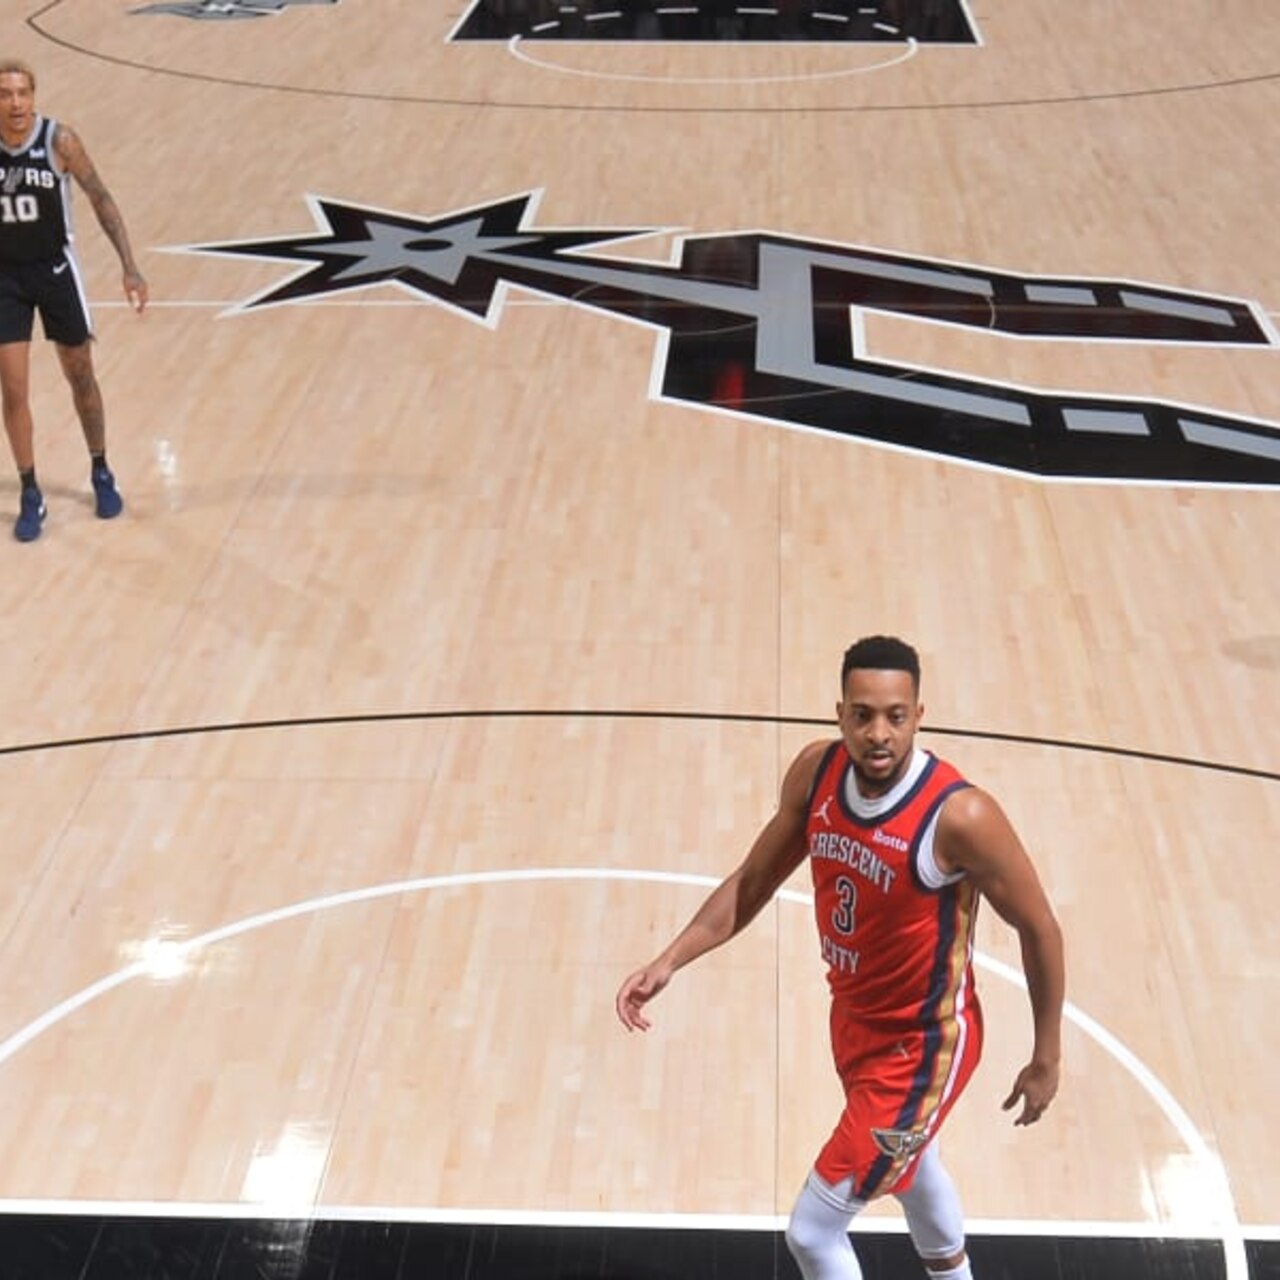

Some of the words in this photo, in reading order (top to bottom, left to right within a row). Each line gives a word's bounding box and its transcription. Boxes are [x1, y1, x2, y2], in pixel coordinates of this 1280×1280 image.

[0, 195, 39, 223] 10
[810, 831, 896, 894] CRESCENT
[831, 875, 857, 935] 3
